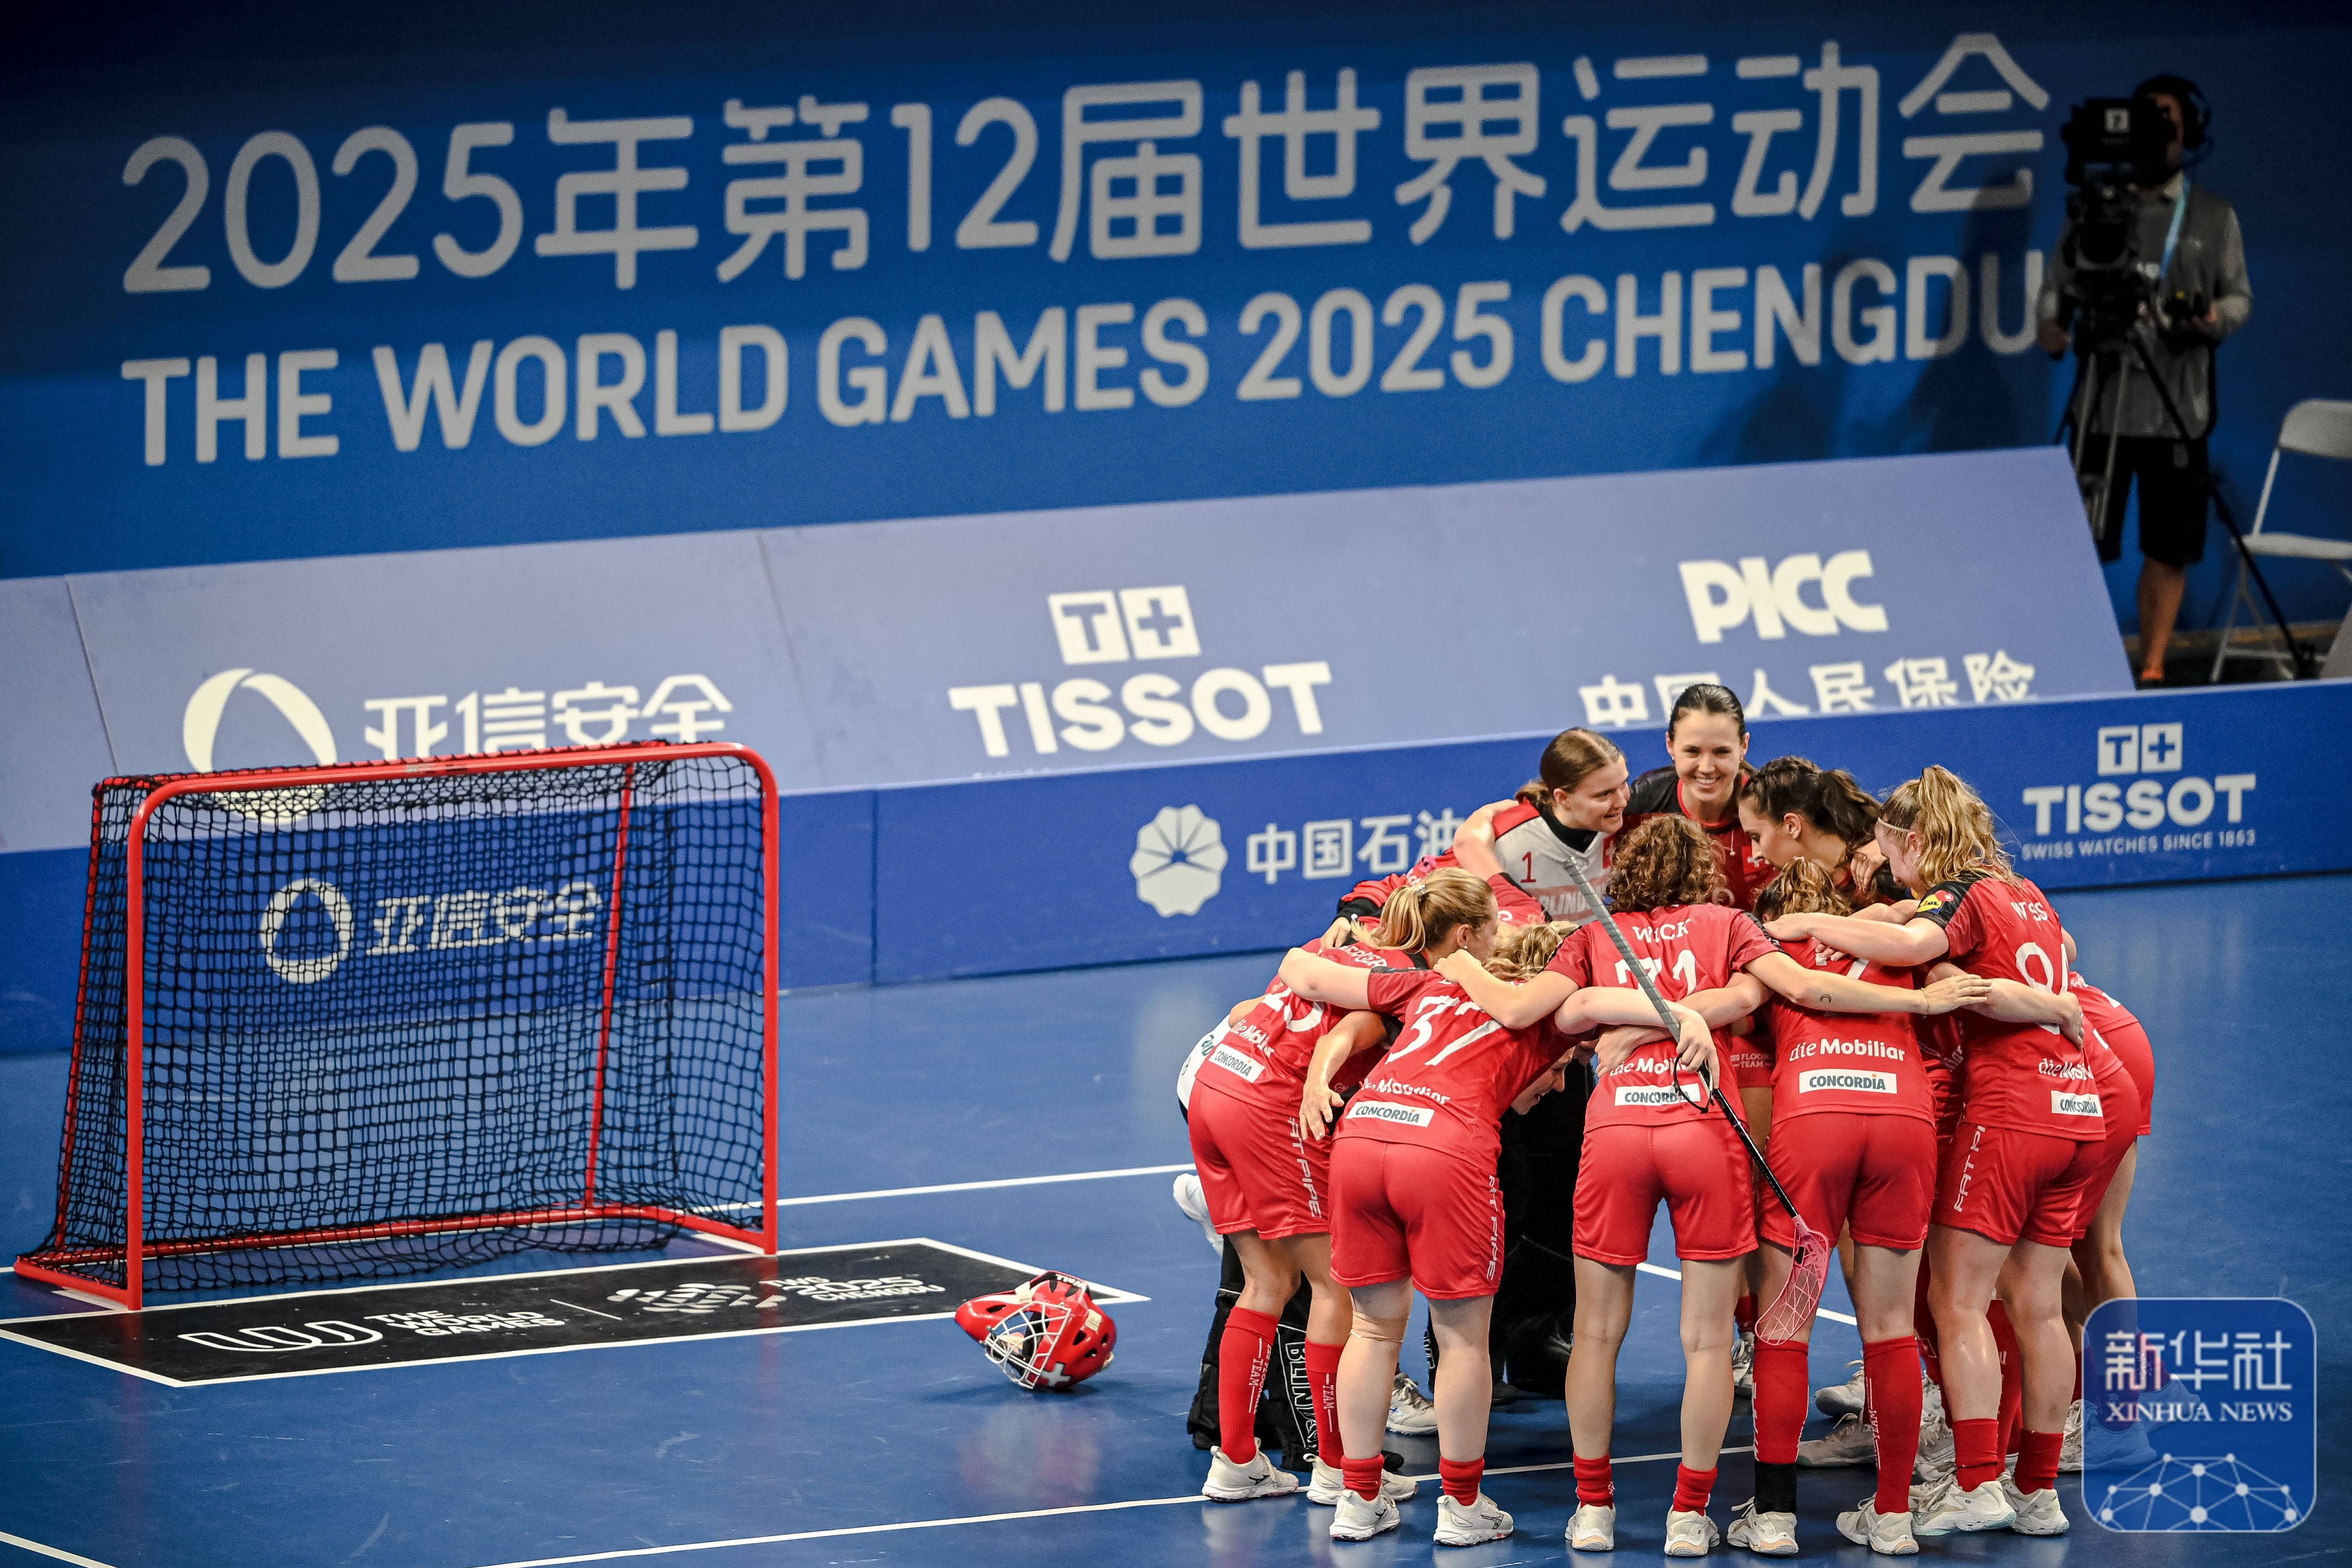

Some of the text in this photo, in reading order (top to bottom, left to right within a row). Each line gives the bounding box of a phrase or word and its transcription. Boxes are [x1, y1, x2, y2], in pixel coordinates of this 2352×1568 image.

[121, 33, 2050, 295] 2025年第12届世界运动会
[121, 249, 2045, 466] THE WORLD GAMES 2025 CHENGDU
[1678, 549, 1889, 644] PICC
[948, 661, 1332, 758] TISSOT
[2023, 774, 2256, 836] TISSOT
[2022, 842, 2073, 860] SWISS
[2079, 837, 2158, 856] WATCHES
[2163, 833, 2213, 851] SINCE
[1520, 852, 1537, 883] 1
[1789, 1038, 1905, 1062] die Mobiliar
[1215, 1050, 1252, 1076] CONCORDIA
[1809, 1073, 1886, 1090] CONCORDIA
[1356, 1105, 1420, 1123] CONCORDIA
[2060, 1098, 2098, 1114] CONCORDIA
[1953, 1125, 1986, 1213] FAT PI
[1296, 1158, 1322, 1218] PIPE
[759, 1276, 831, 1287] TWG
[782, 1276, 924, 1296] 2025
[811, 1284, 946, 1301] CHENGDU
[363, 1310, 455, 1322] THE
[386, 1311, 545, 1329] WORLD
[414, 1318, 566, 1336] GAMES
[1248, 1358, 1264, 1386] TEAM
[1322, 1384, 1334, 1409] TEAM
